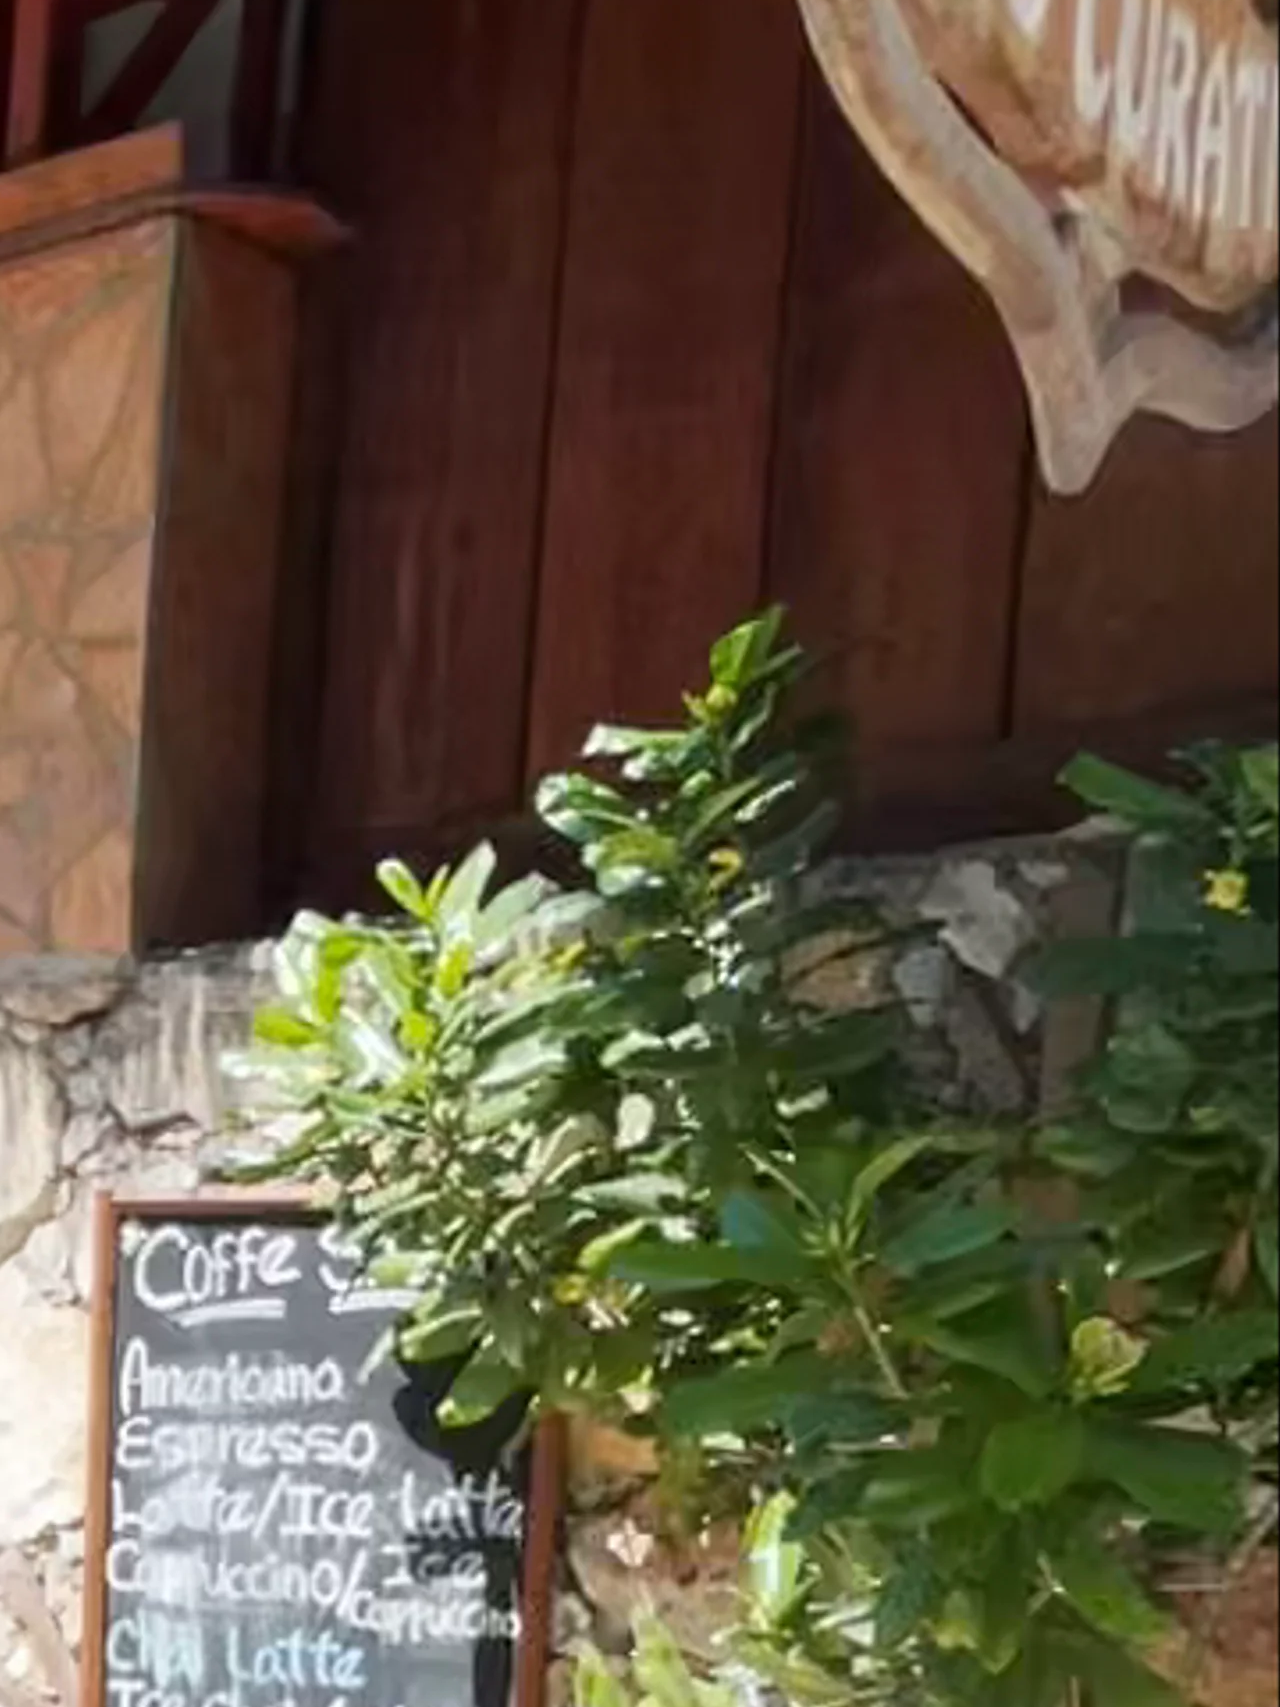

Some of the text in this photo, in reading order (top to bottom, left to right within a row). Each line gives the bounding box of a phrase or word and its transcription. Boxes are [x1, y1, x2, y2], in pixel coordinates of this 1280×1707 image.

[134, 1225, 301, 1310] Coffe
[120, 1337, 343, 1415] Americano
[115, 1416, 379, 1475] Espresso
[381, 1543, 487, 1588] Ice
